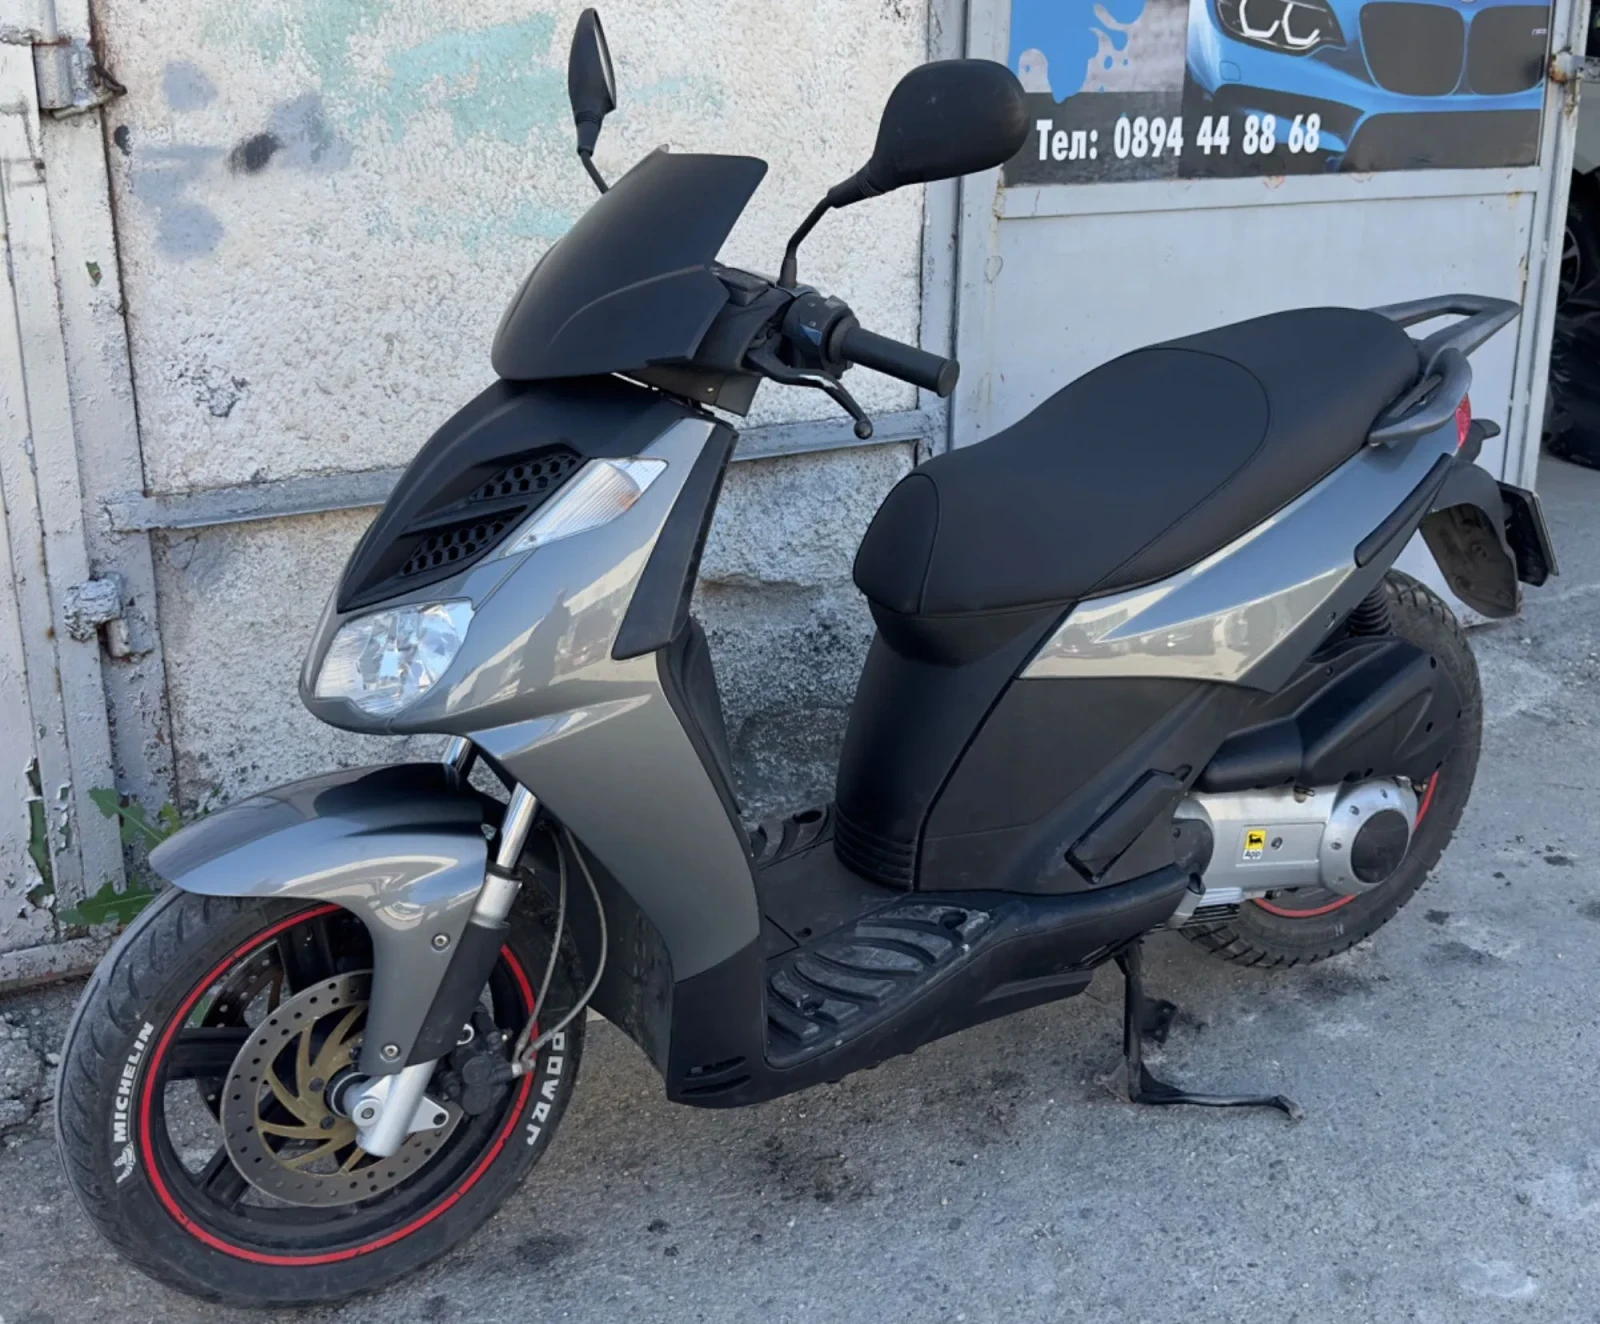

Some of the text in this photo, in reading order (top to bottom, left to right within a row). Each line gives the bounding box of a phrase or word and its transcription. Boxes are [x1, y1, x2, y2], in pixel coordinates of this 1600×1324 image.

[1036, 113, 1321, 161] Тел: 0894 44 88 68
[113, 1021, 154, 1143] MICHELIN
